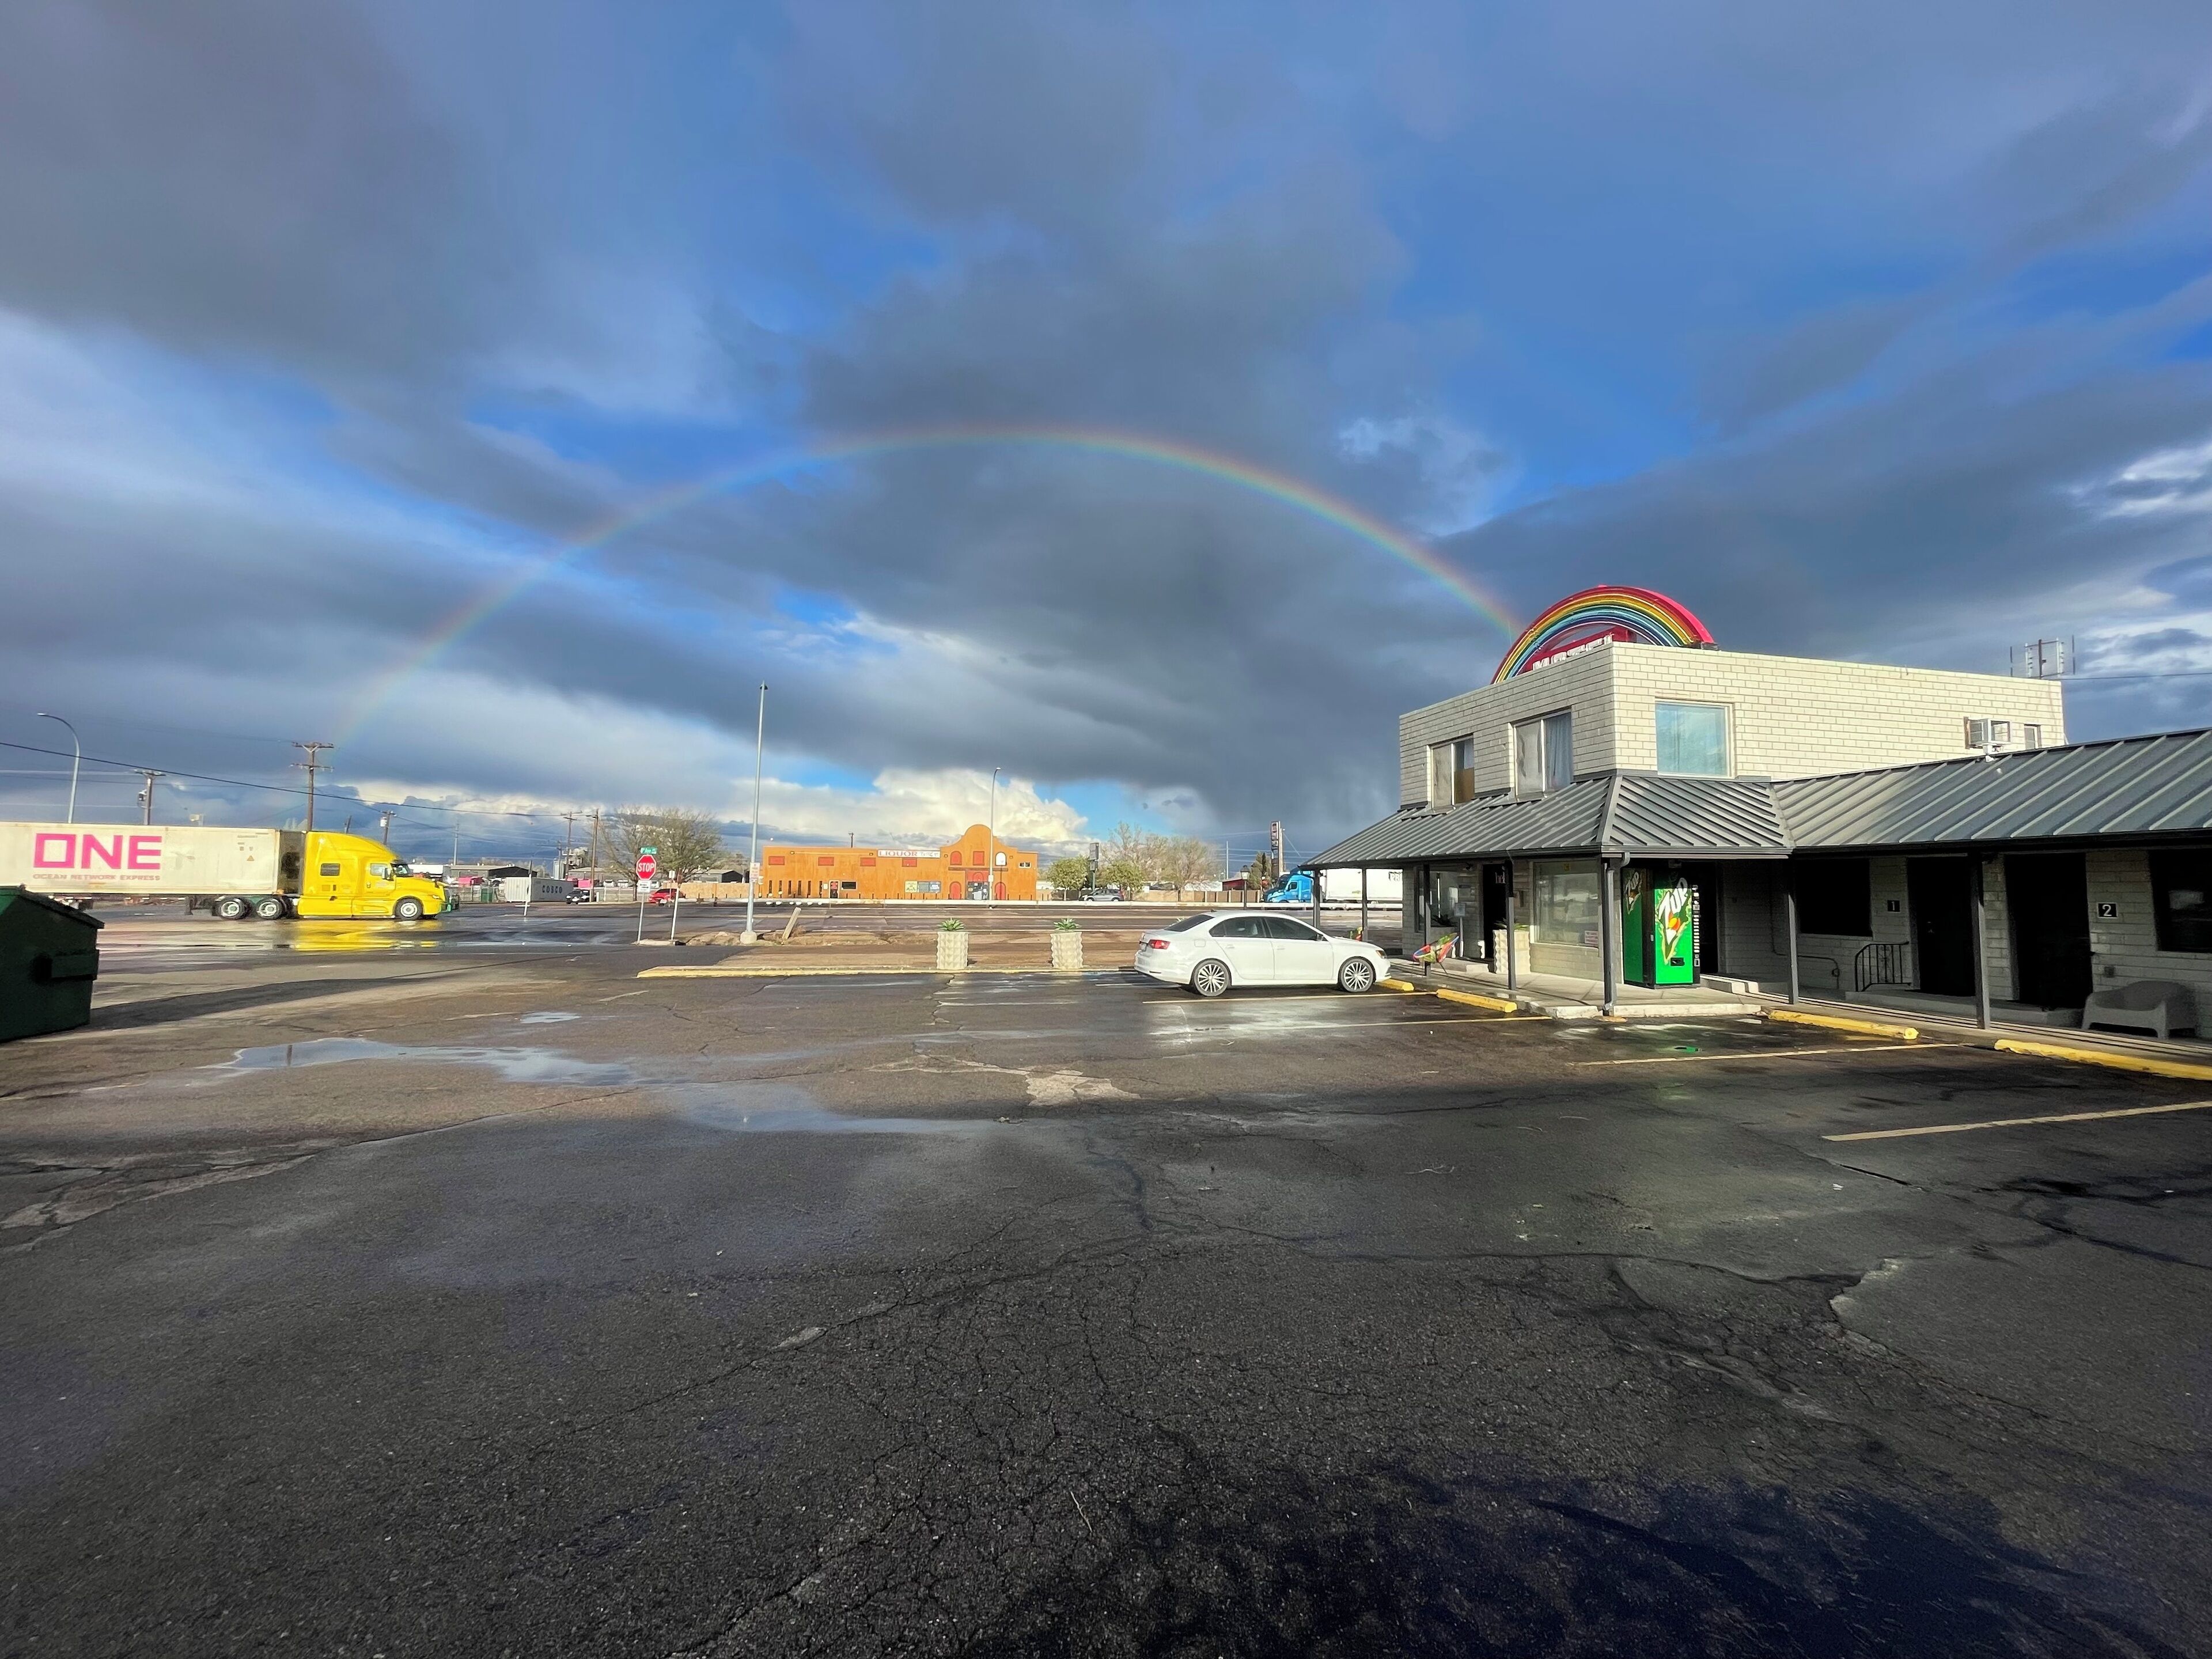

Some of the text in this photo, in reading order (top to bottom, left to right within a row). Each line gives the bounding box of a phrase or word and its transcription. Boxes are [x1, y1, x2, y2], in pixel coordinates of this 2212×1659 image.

[33, 833, 162, 870] ONE
[638, 862, 654, 873] STOP
[541, 885, 563, 894] COSCO
[1891, 901, 1895, 911] 1
[2102, 904, 2112, 916] 2
